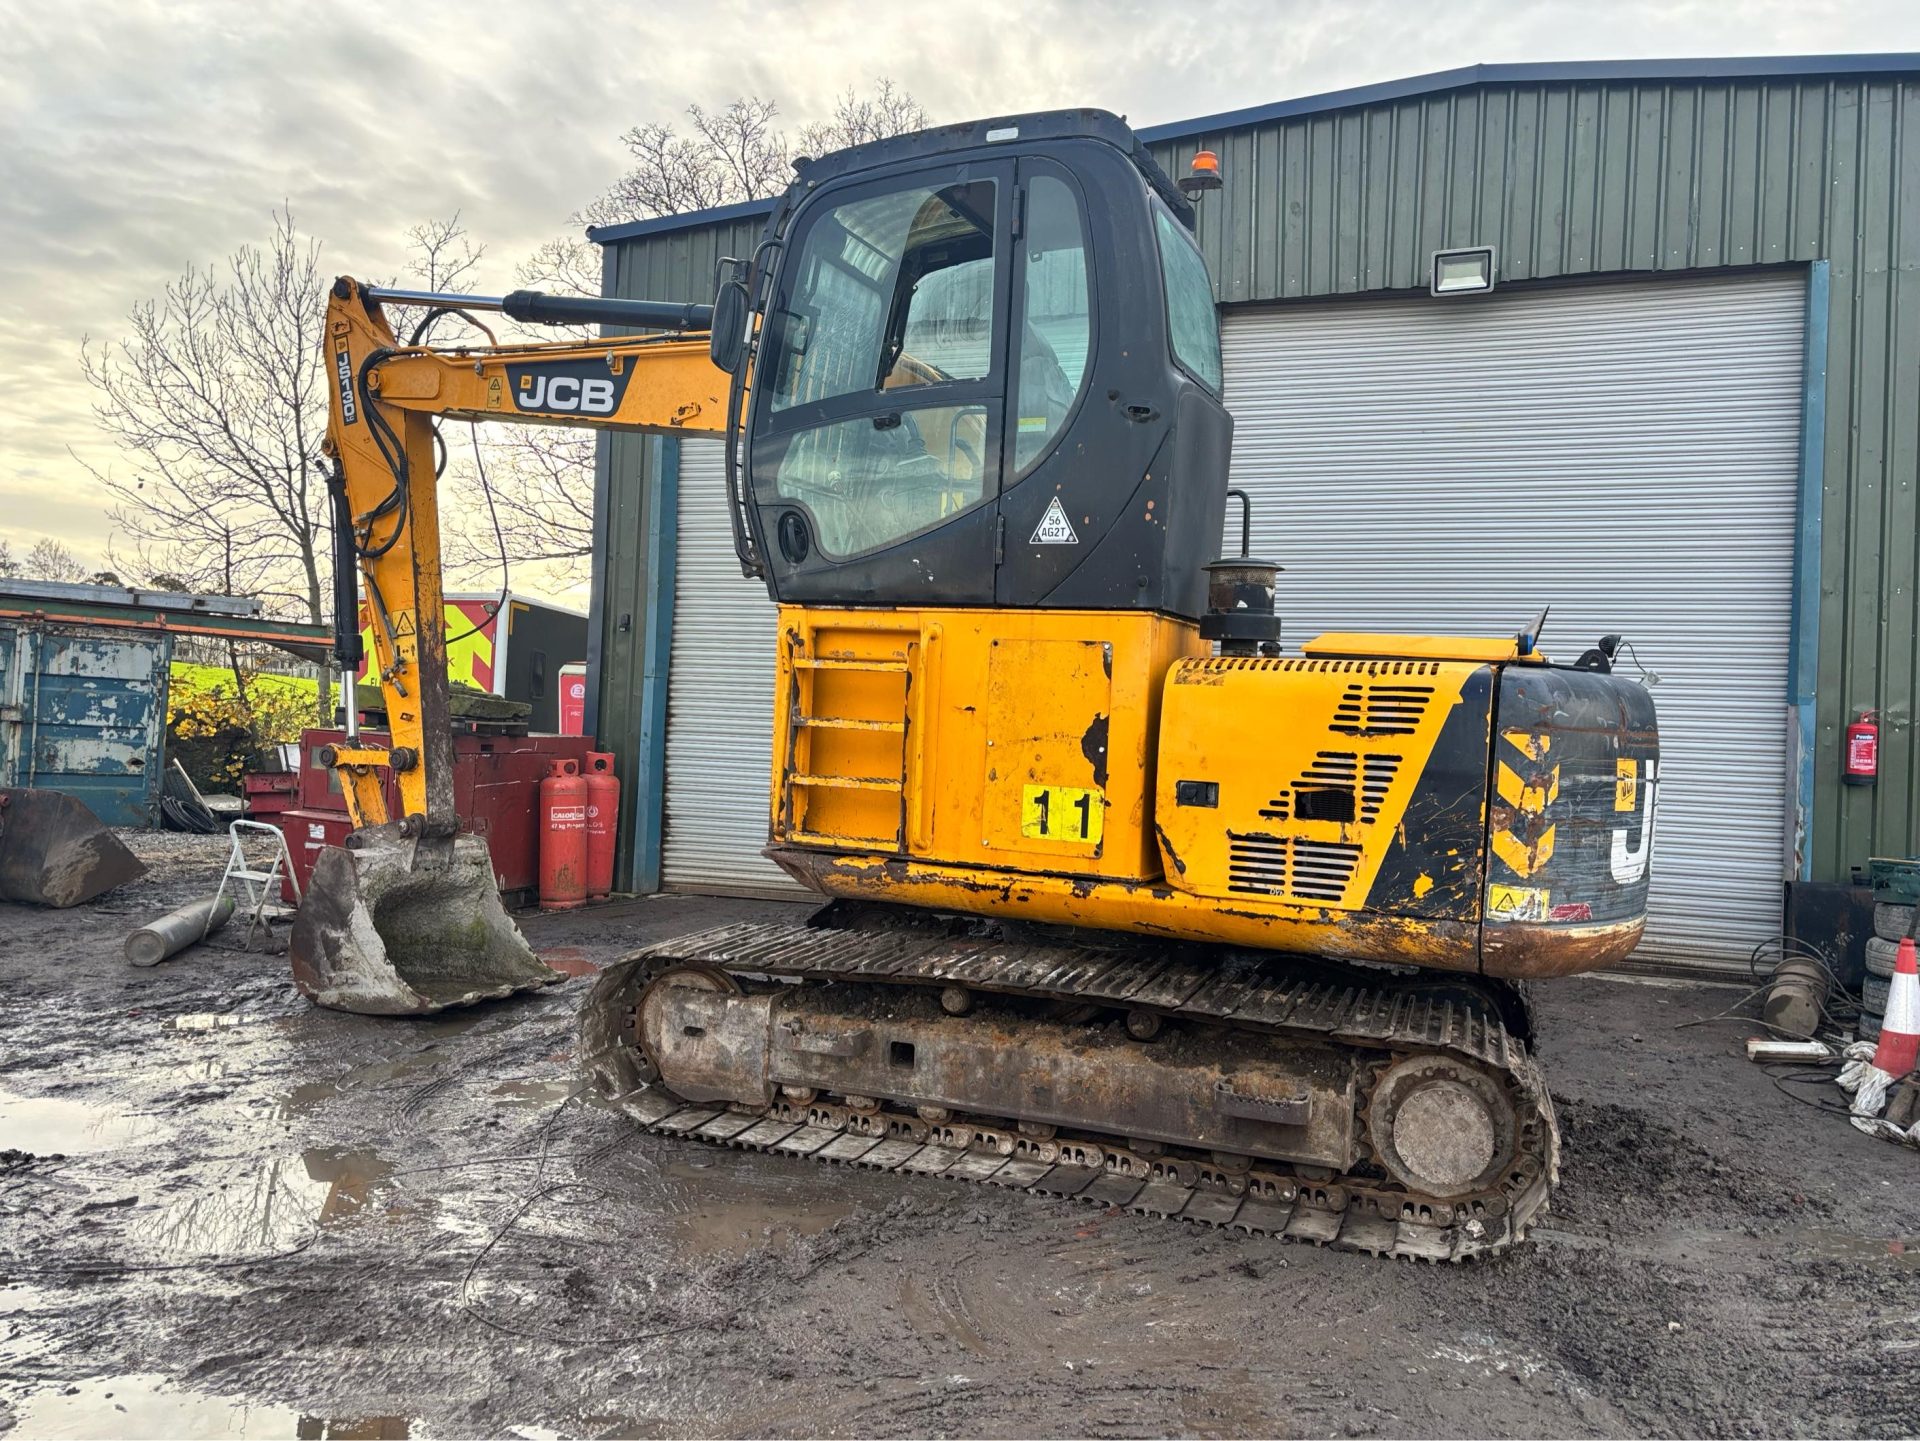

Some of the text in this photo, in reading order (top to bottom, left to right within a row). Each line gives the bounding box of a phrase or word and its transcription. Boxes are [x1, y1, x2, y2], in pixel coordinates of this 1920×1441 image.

[339, 353, 355, 416] JS130
[519, 376, 614, 412] JCB
[1042, 528, 1066, 537] AG2T
[1049, 515, 1061, 526] 56
[1611, 759, 1660, 885] J
